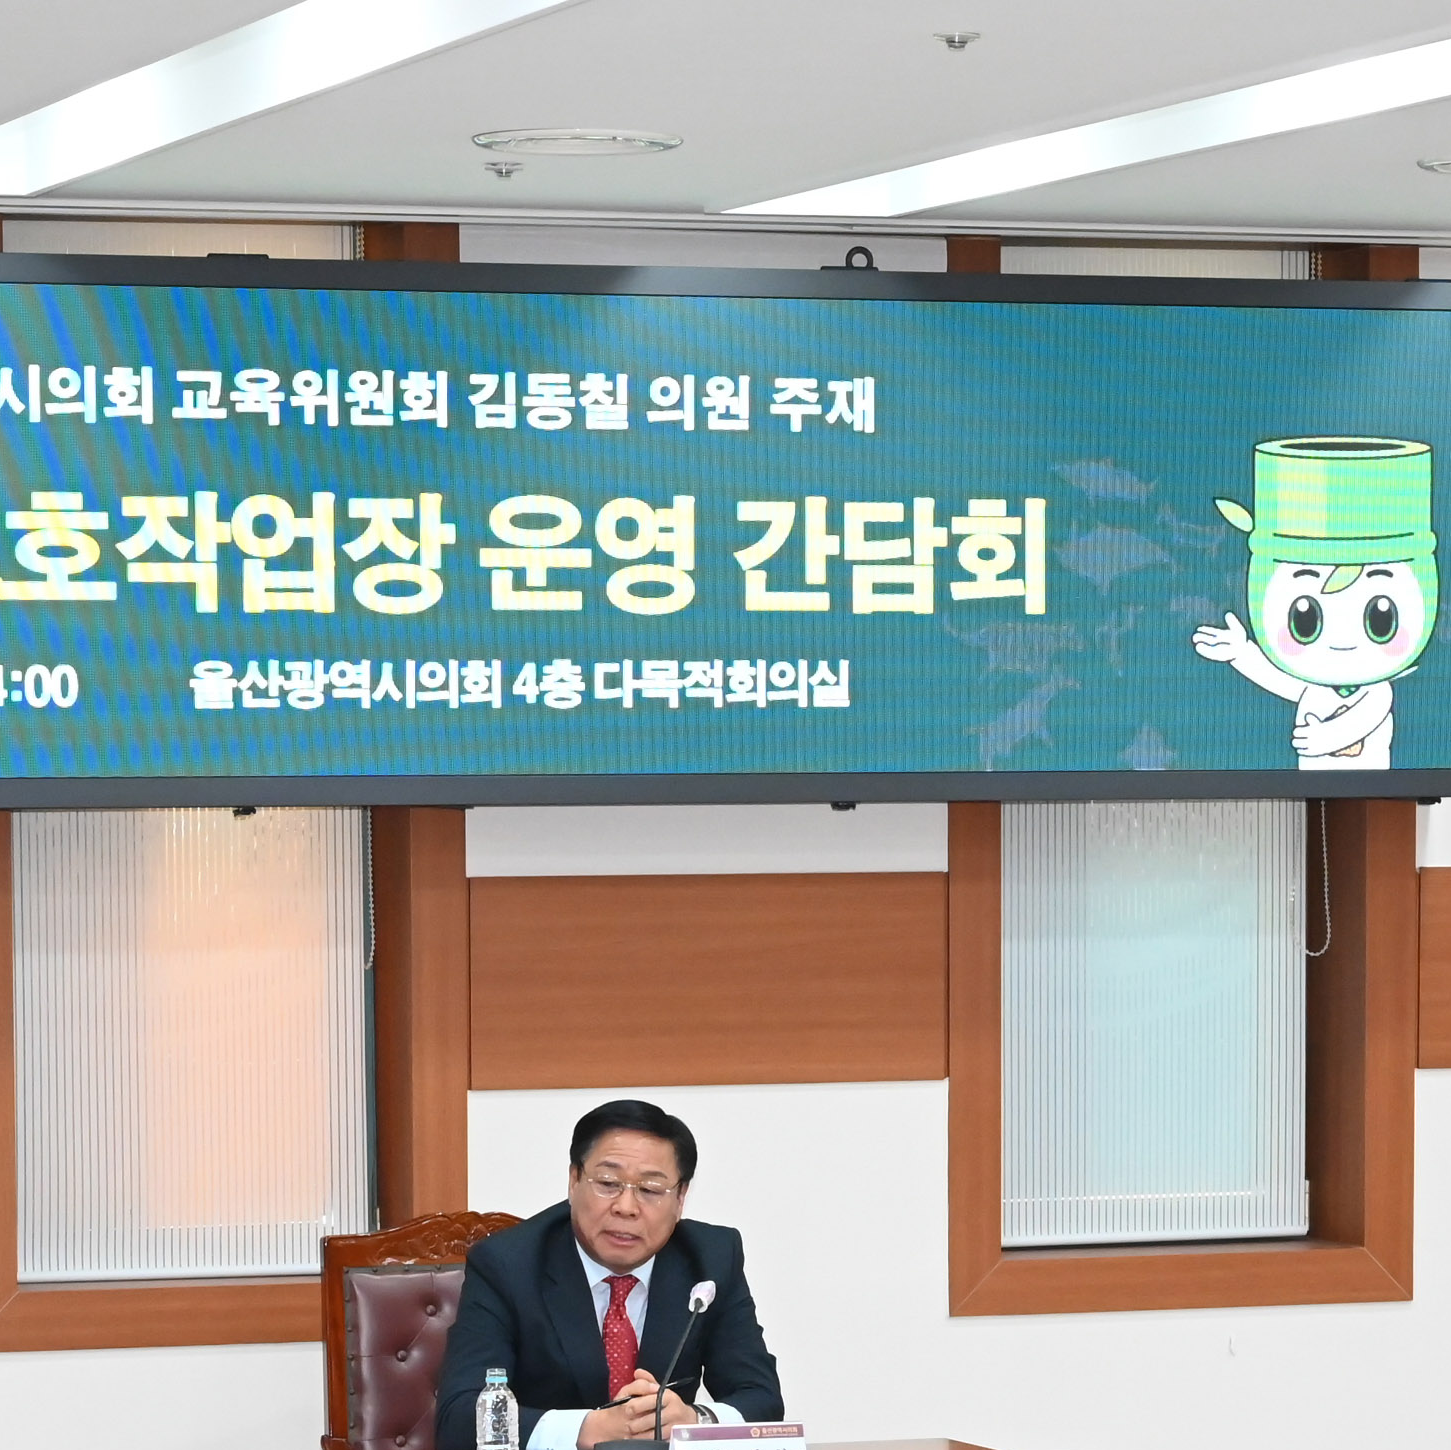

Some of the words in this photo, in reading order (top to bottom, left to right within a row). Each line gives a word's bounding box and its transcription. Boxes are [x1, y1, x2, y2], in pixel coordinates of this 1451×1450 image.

[172, 370, 449, 429] 교육위원회
[469, 373, 630, 432] 김동칠
[647, 375, 752, 432] 의원
[770, 377, 876, 434] 주재
[480, 495, 697, 617] 운영
[734, 496, 1047, 616] 간담회
[189, 660, 503, 711] 울산광역시의회
[513, 659, 587, 711] 4층
[595, 659, 852, 710] 다목적회의실
